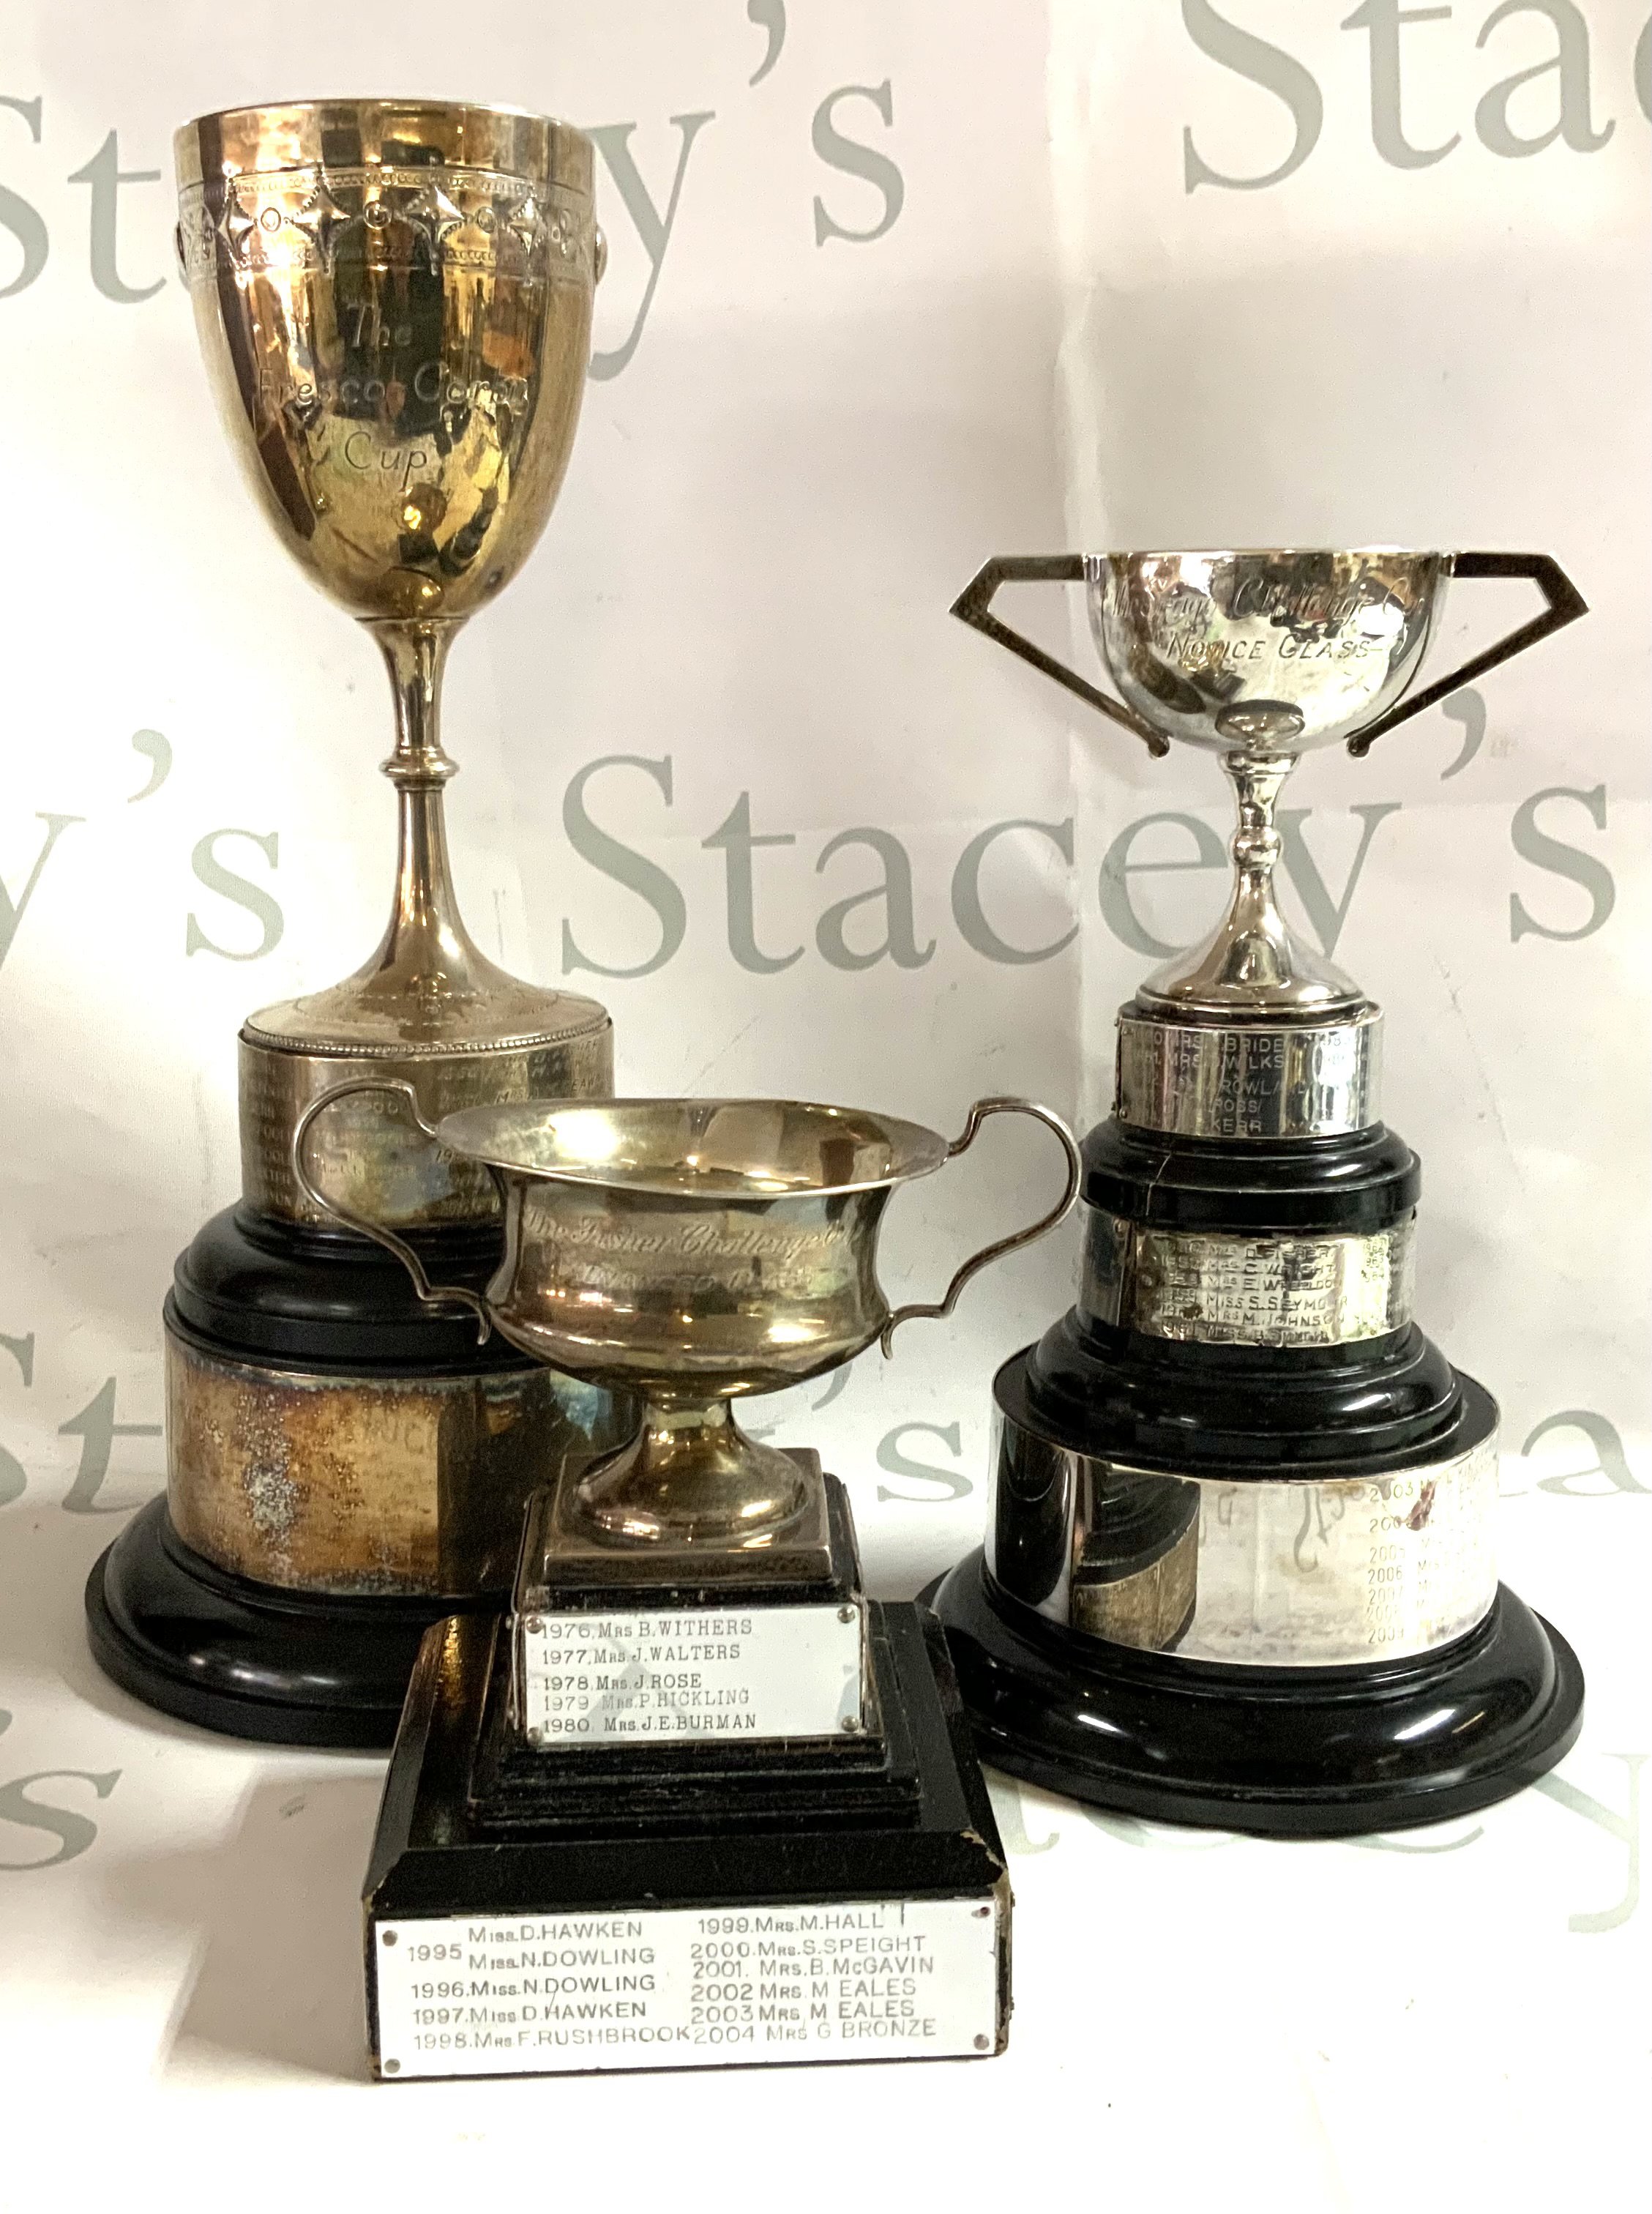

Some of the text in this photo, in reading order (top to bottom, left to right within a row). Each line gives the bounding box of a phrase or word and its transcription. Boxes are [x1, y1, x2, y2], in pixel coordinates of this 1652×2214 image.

[1181, 0, 1652, 195] Sta
[345, 430, 427, 492] Cup
[408, 1942, 463, 1962] 1995
[690, 1983, 754, 2002] 2002
[812, 1980, 829, 1998] M
[840, 1977, 916, 1998] EALES
[691, 2004, 754, 2024] 2003
[810, 2002, 827, 2021] M
[838, 1999, 915, 2019] EALES
[694, 2024, 755, 2045] 2004
[842, 2018, 937, 2039] BRONZE
